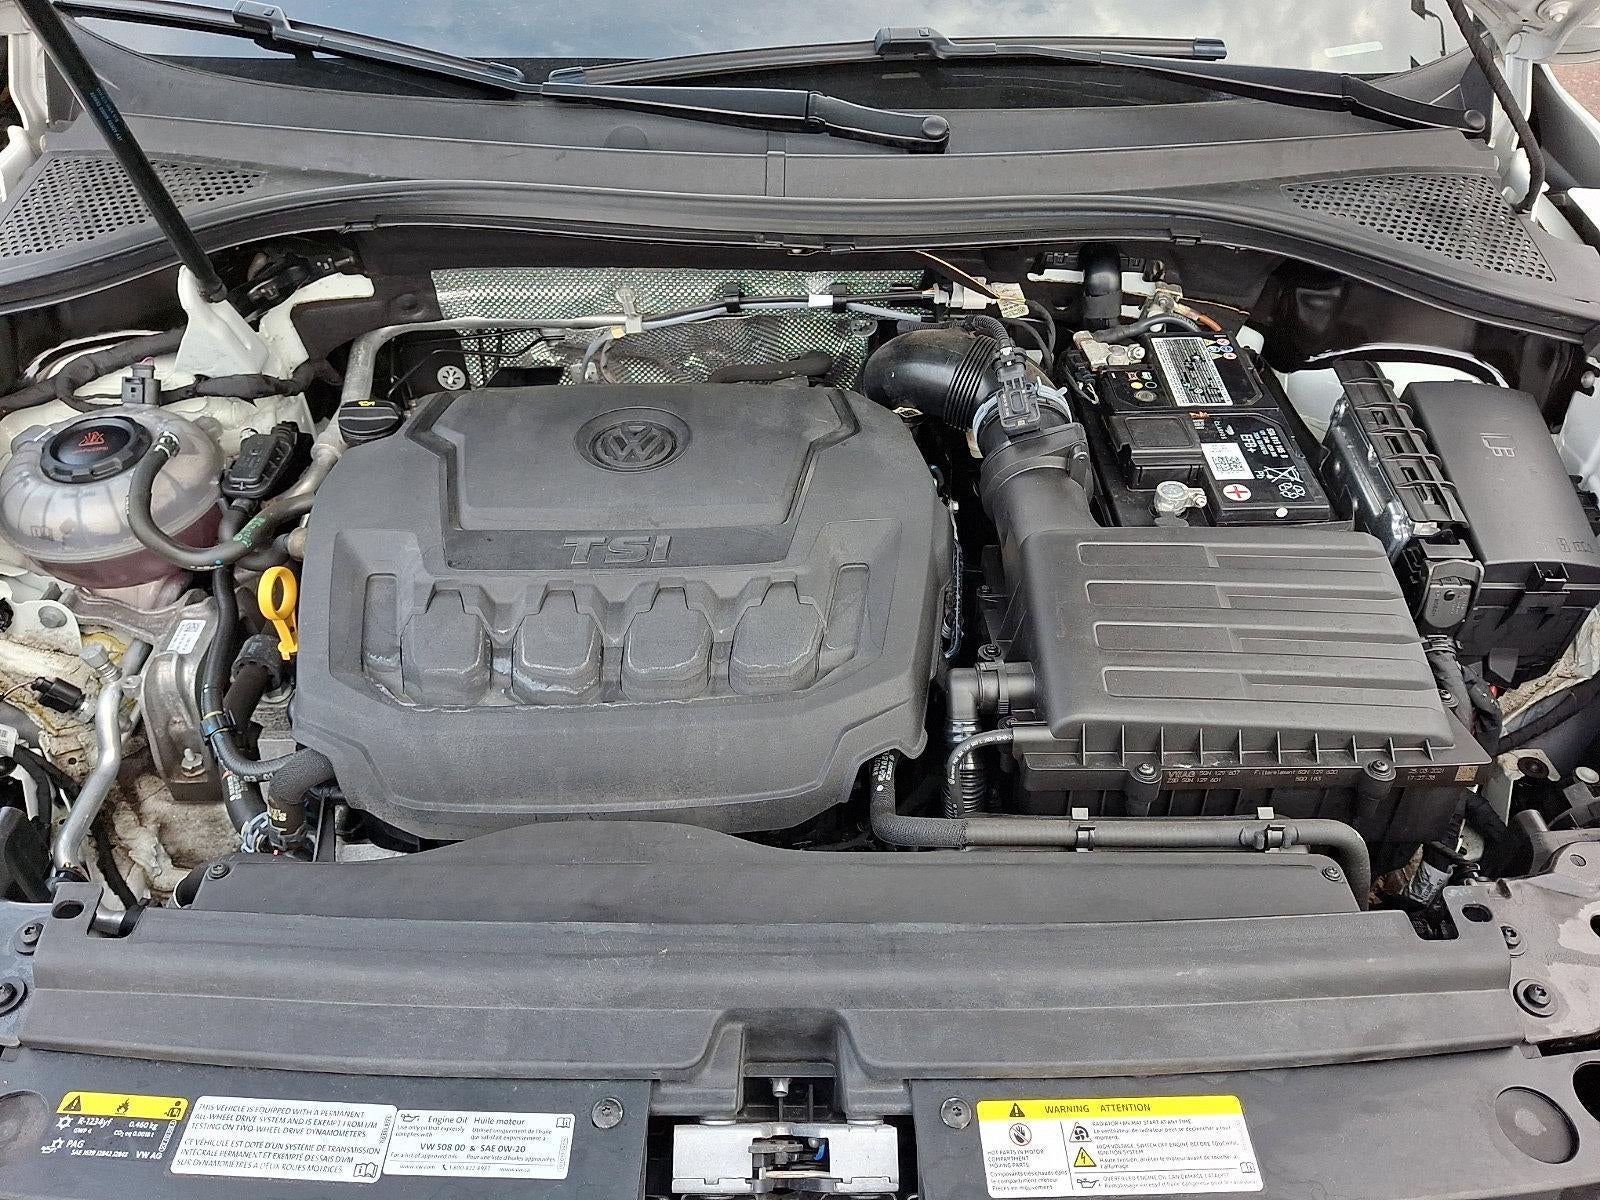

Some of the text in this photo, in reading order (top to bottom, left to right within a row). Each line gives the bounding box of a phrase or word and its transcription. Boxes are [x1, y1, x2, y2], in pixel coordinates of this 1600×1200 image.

[1240, 434, 1258, 454] EFB+
[1254, 470, 1265, 479] Pb
[563, 535, 673, 564] TSI
[1045, 1103, 1151, 1114] WARNING ATTENTION
[77, 1117, 112, 1127] R-1234yf
[148, 1122, 158, 1130] kg
[428, 1115, 454, 1125] Engine
[236, 1124, 280, 1133] TWO-WHEEL
[306, 1128, 365, 1137] DYNAMOMETERS
[66, 1139, 84, 1148] PAG
[328, 1145, 380, 1154] TRANSMISSION
[306, 1164, 342, 1172] MOTRICES
